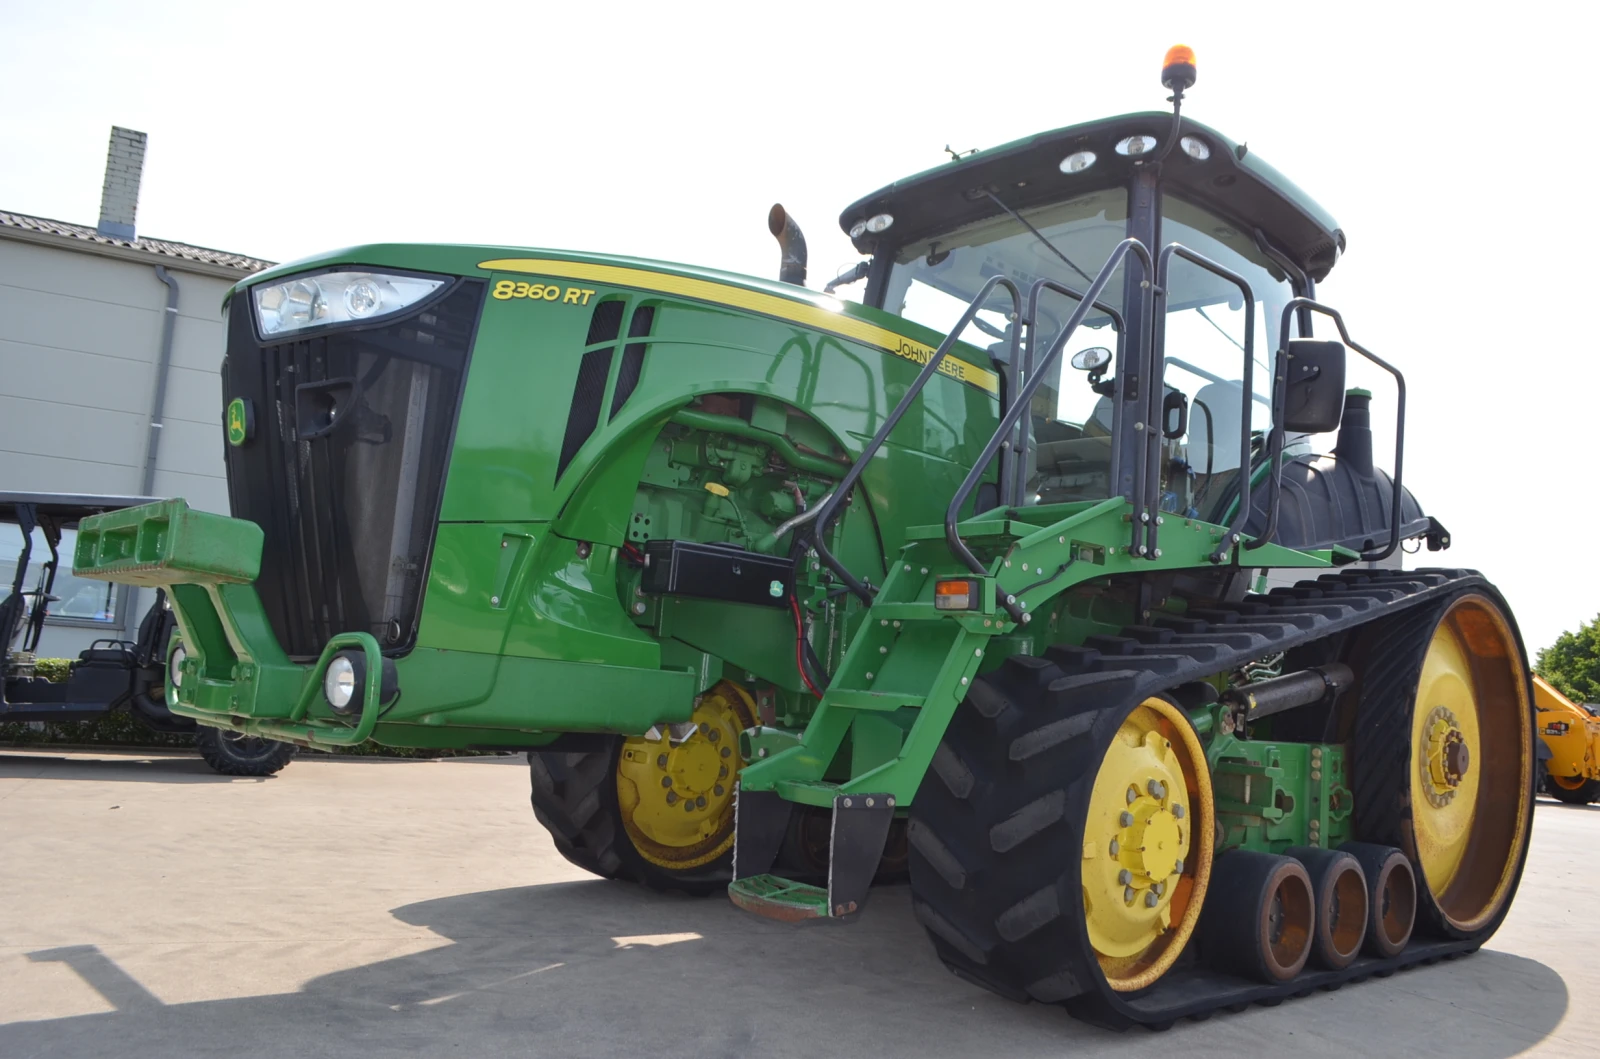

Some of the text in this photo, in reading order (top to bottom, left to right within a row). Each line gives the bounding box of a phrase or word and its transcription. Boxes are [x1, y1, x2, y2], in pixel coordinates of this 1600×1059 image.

[492, 280, 595, 306] 8360 RT
[895, 338, 928, 364] JOHN
